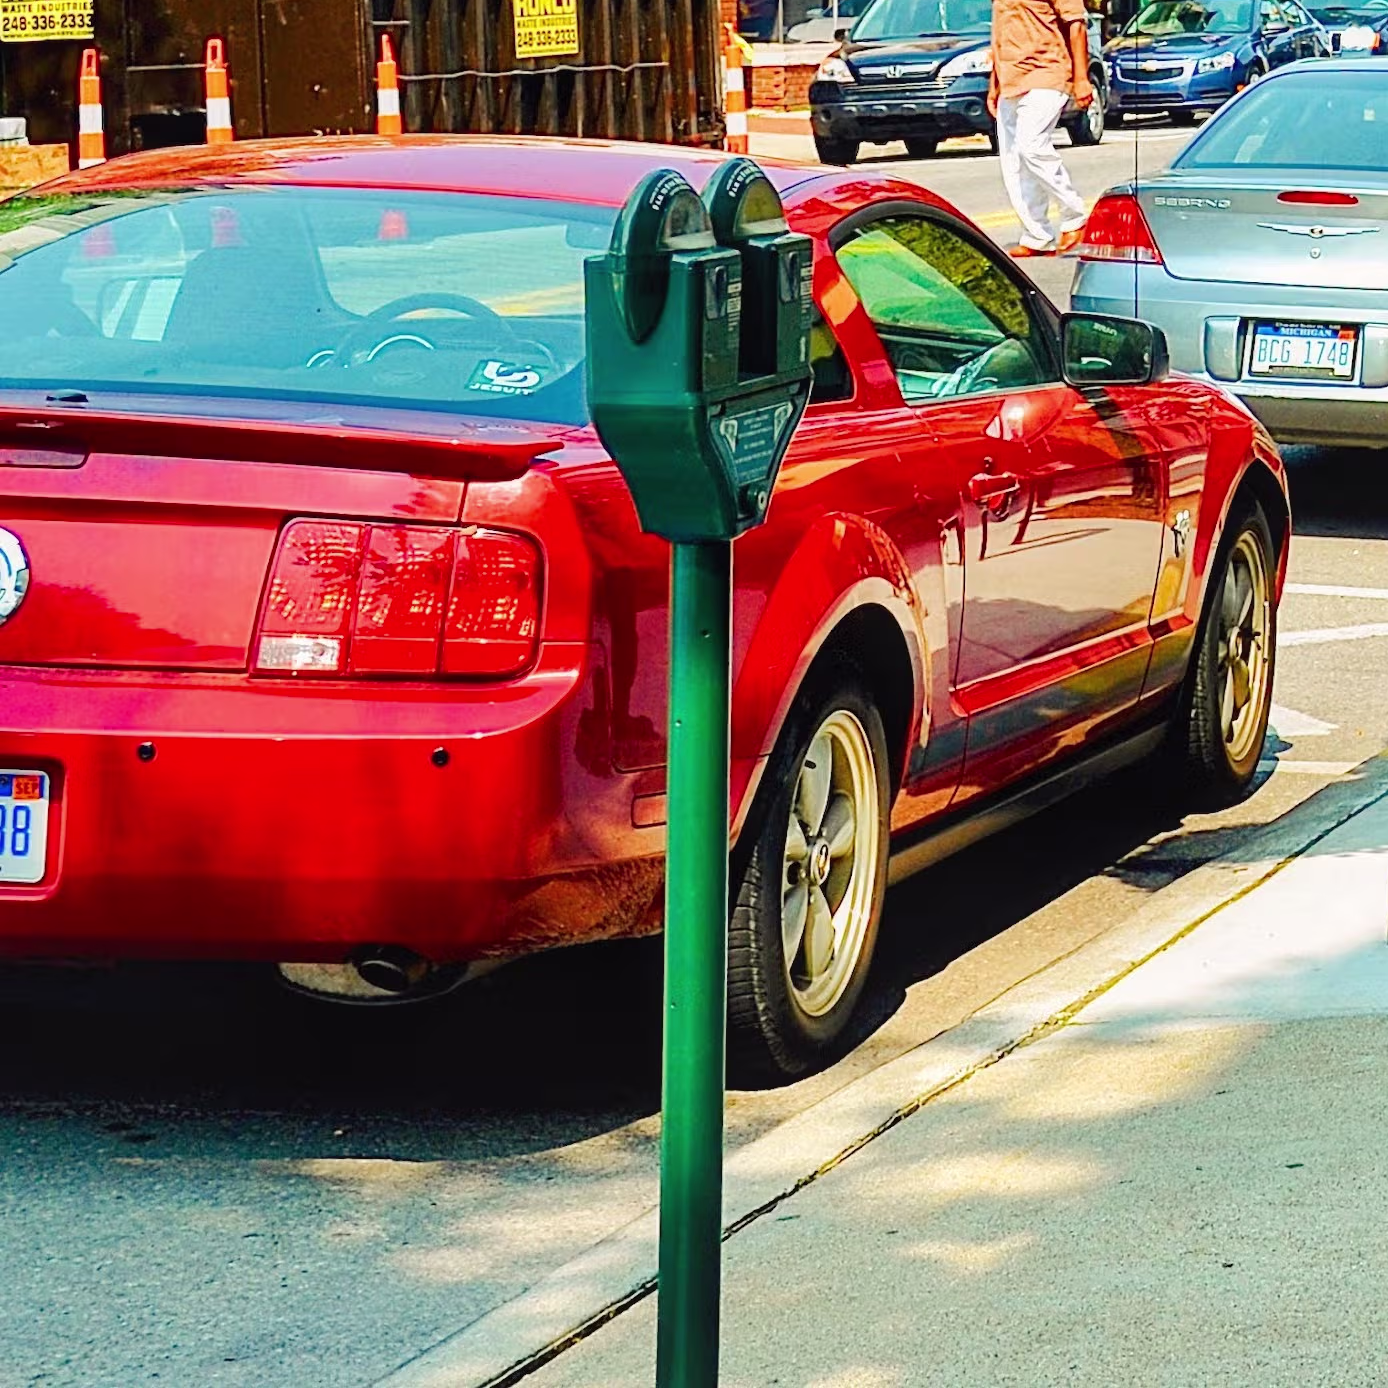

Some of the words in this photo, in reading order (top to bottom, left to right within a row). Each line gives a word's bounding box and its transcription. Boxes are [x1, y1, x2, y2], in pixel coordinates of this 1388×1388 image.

[2, 4, 33, 14] WASTE
[1279, 326, 1333, 338] MICHIGAN
[1257, 338, 1292, 364] BCG
[1303, 340, 1350, 367] 1748
[468, 382, 536, 396] JESUIT
